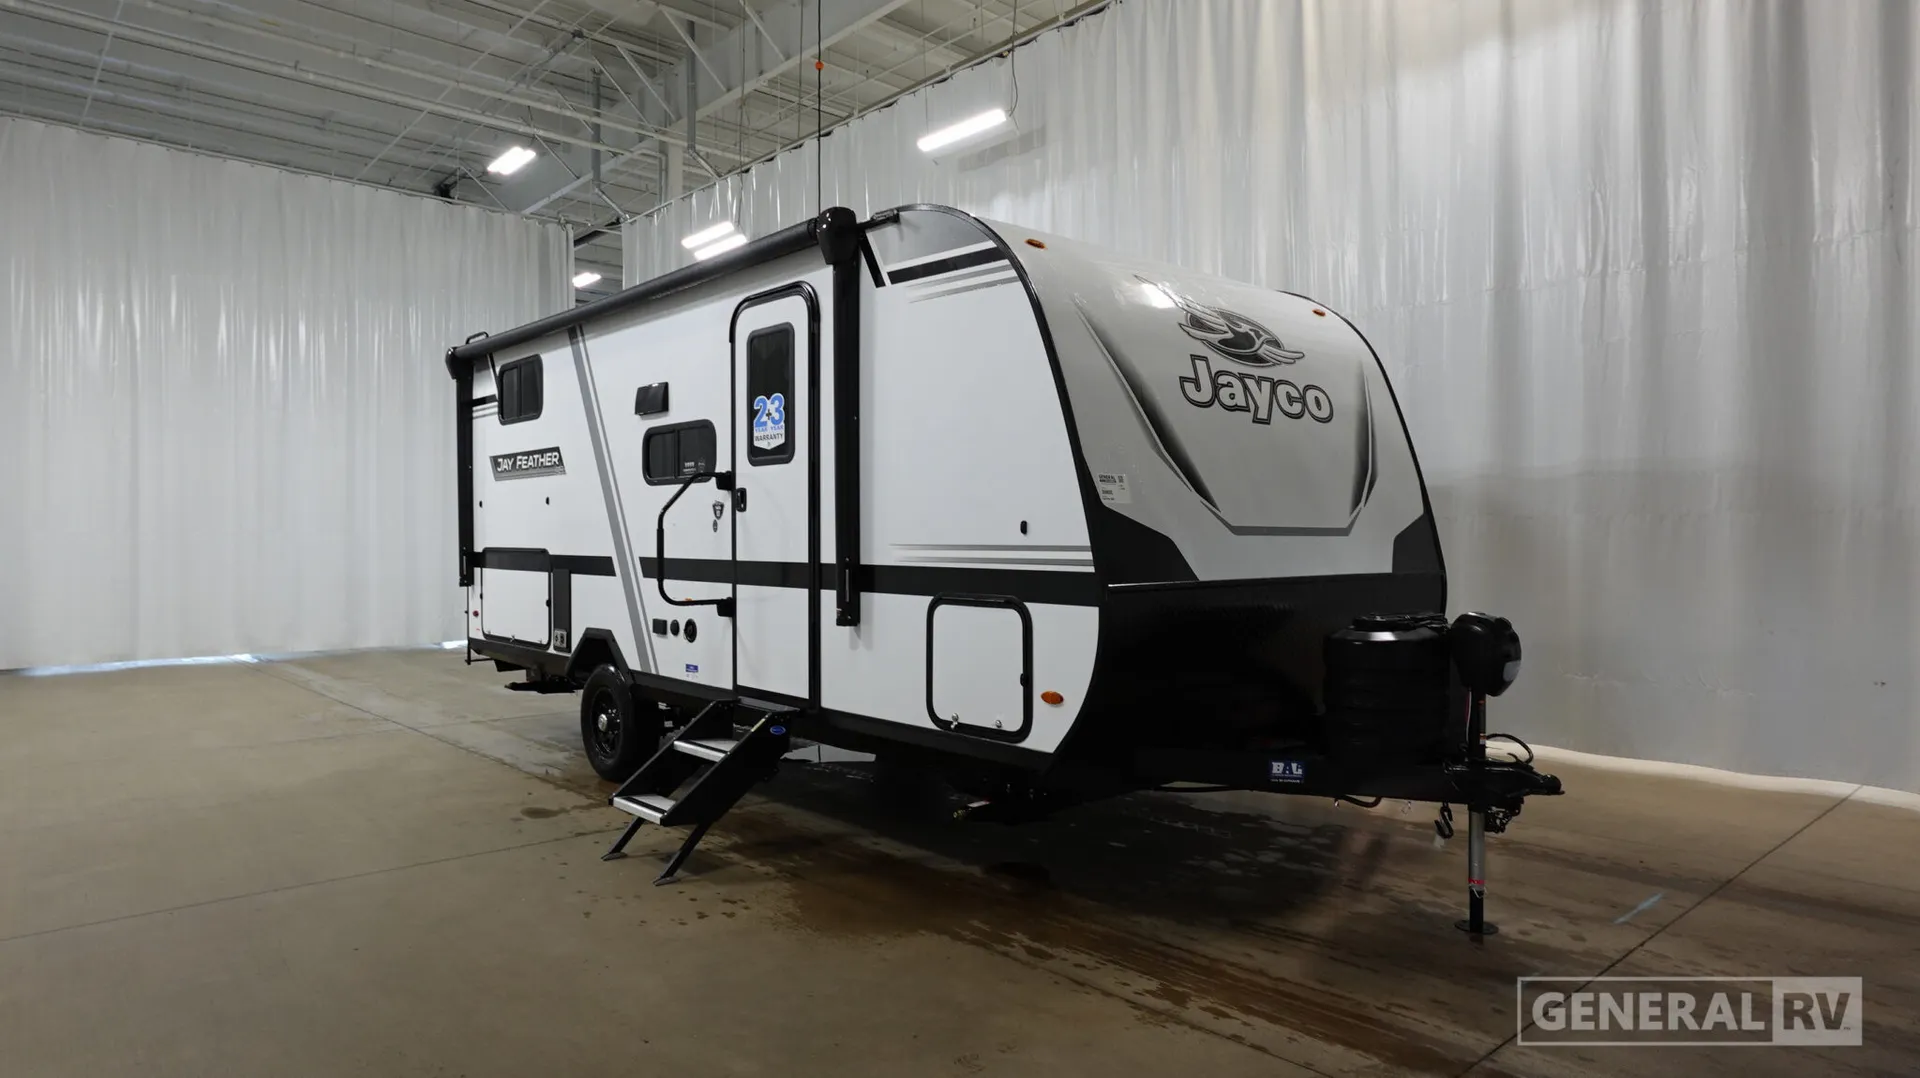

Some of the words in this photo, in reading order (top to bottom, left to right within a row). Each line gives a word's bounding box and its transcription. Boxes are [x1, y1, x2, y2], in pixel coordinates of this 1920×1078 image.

[1179, 354, 1334, 425] Jayco
[755, 433, 784, 442] WARRANTY
[497, 458, 514, 472] JAY
[515, 452, 560, 470] FEATHER
